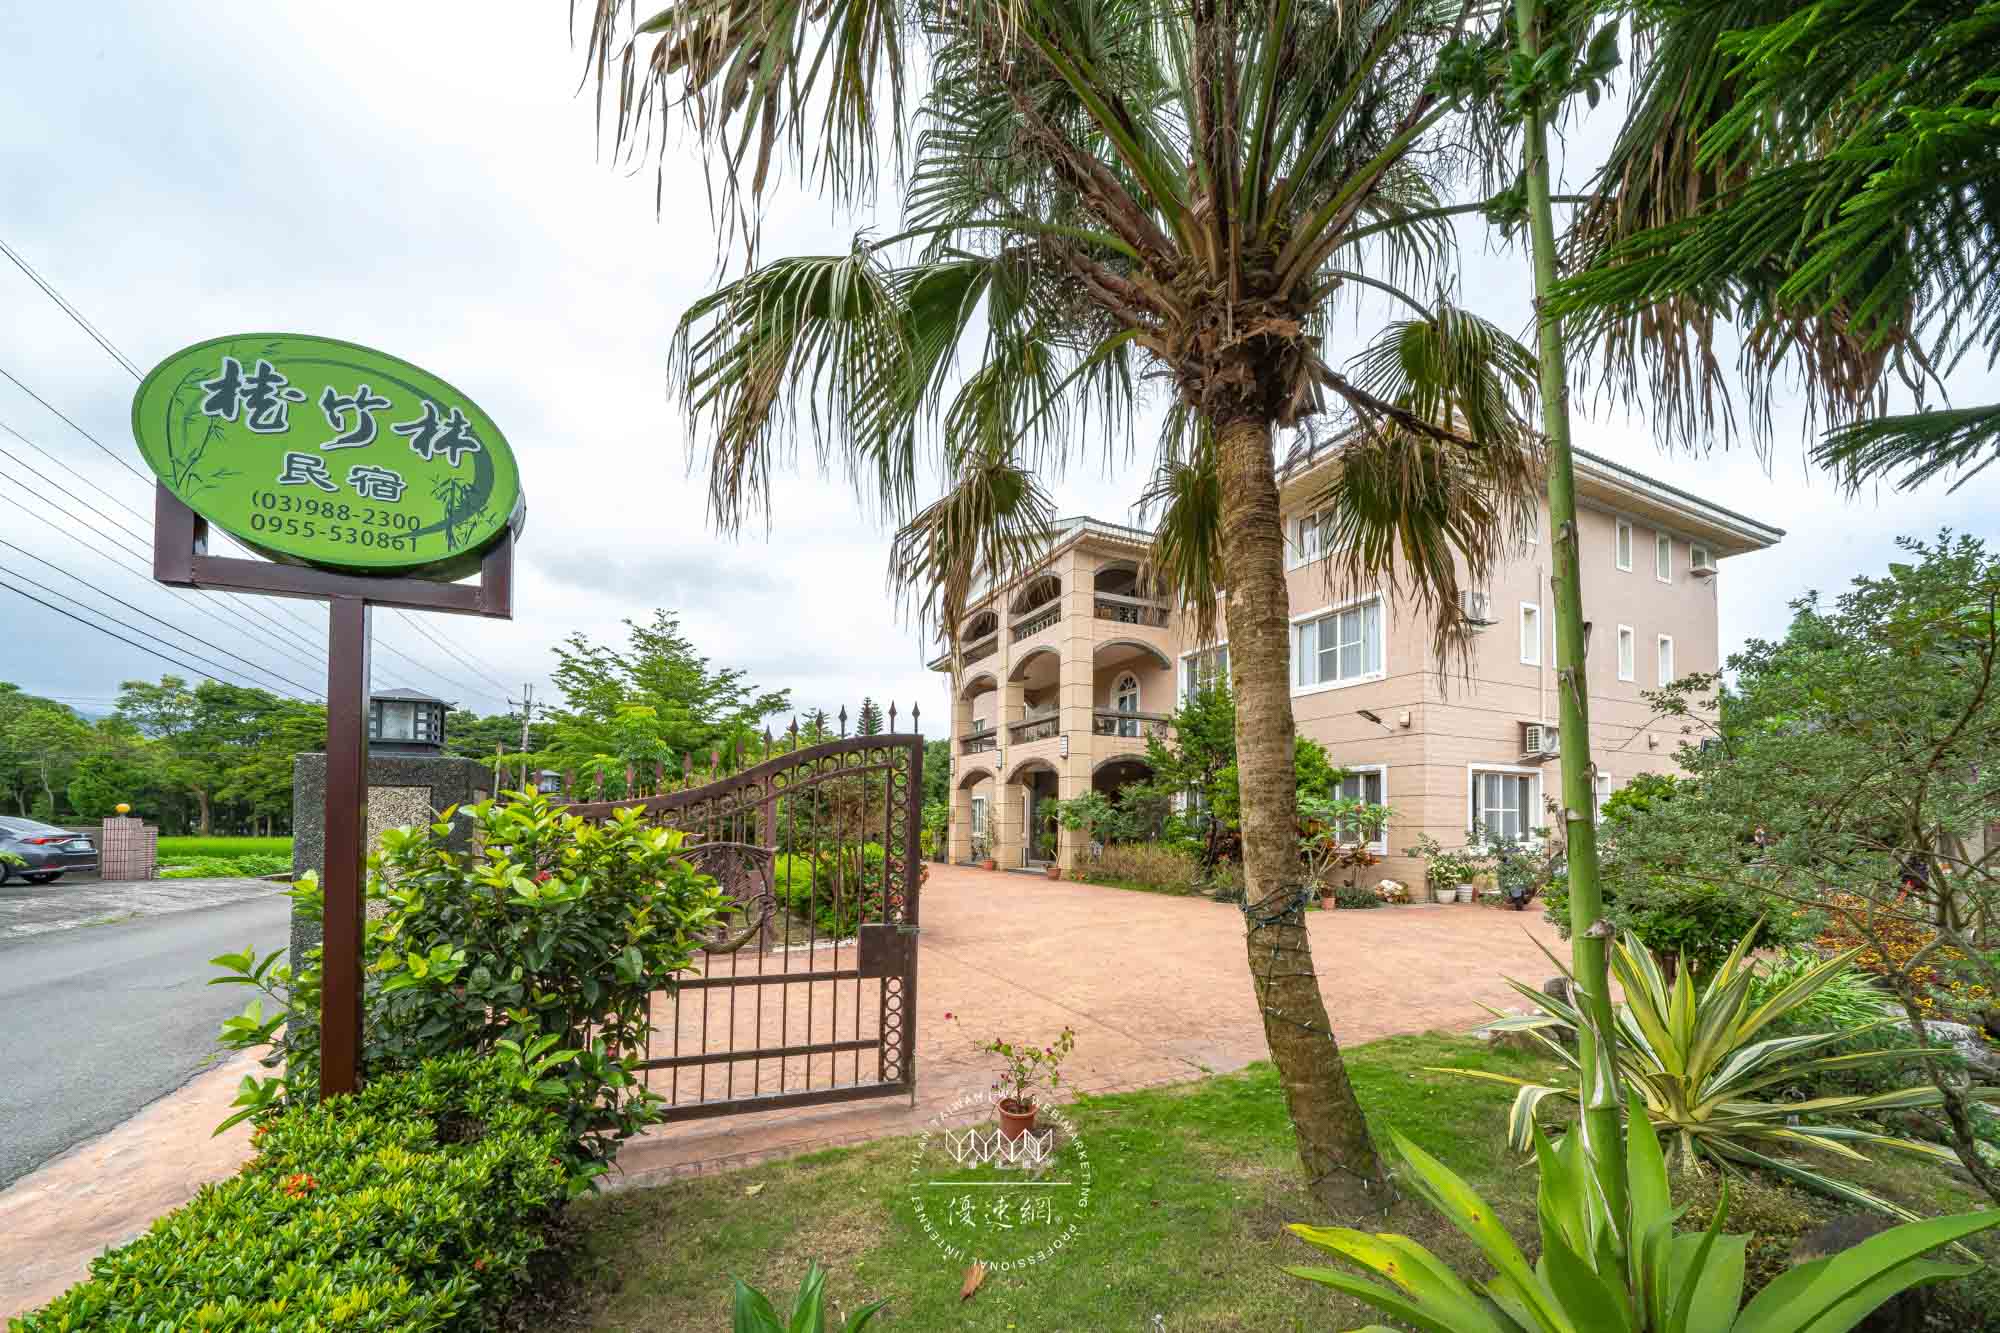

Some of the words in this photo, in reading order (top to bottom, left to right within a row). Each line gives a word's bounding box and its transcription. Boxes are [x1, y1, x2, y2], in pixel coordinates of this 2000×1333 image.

[278, 451, 407, 502] 民宿
[252, 490, 421, 532] (03)988-2300
[250, 513, 418, 553] 0955-530861
